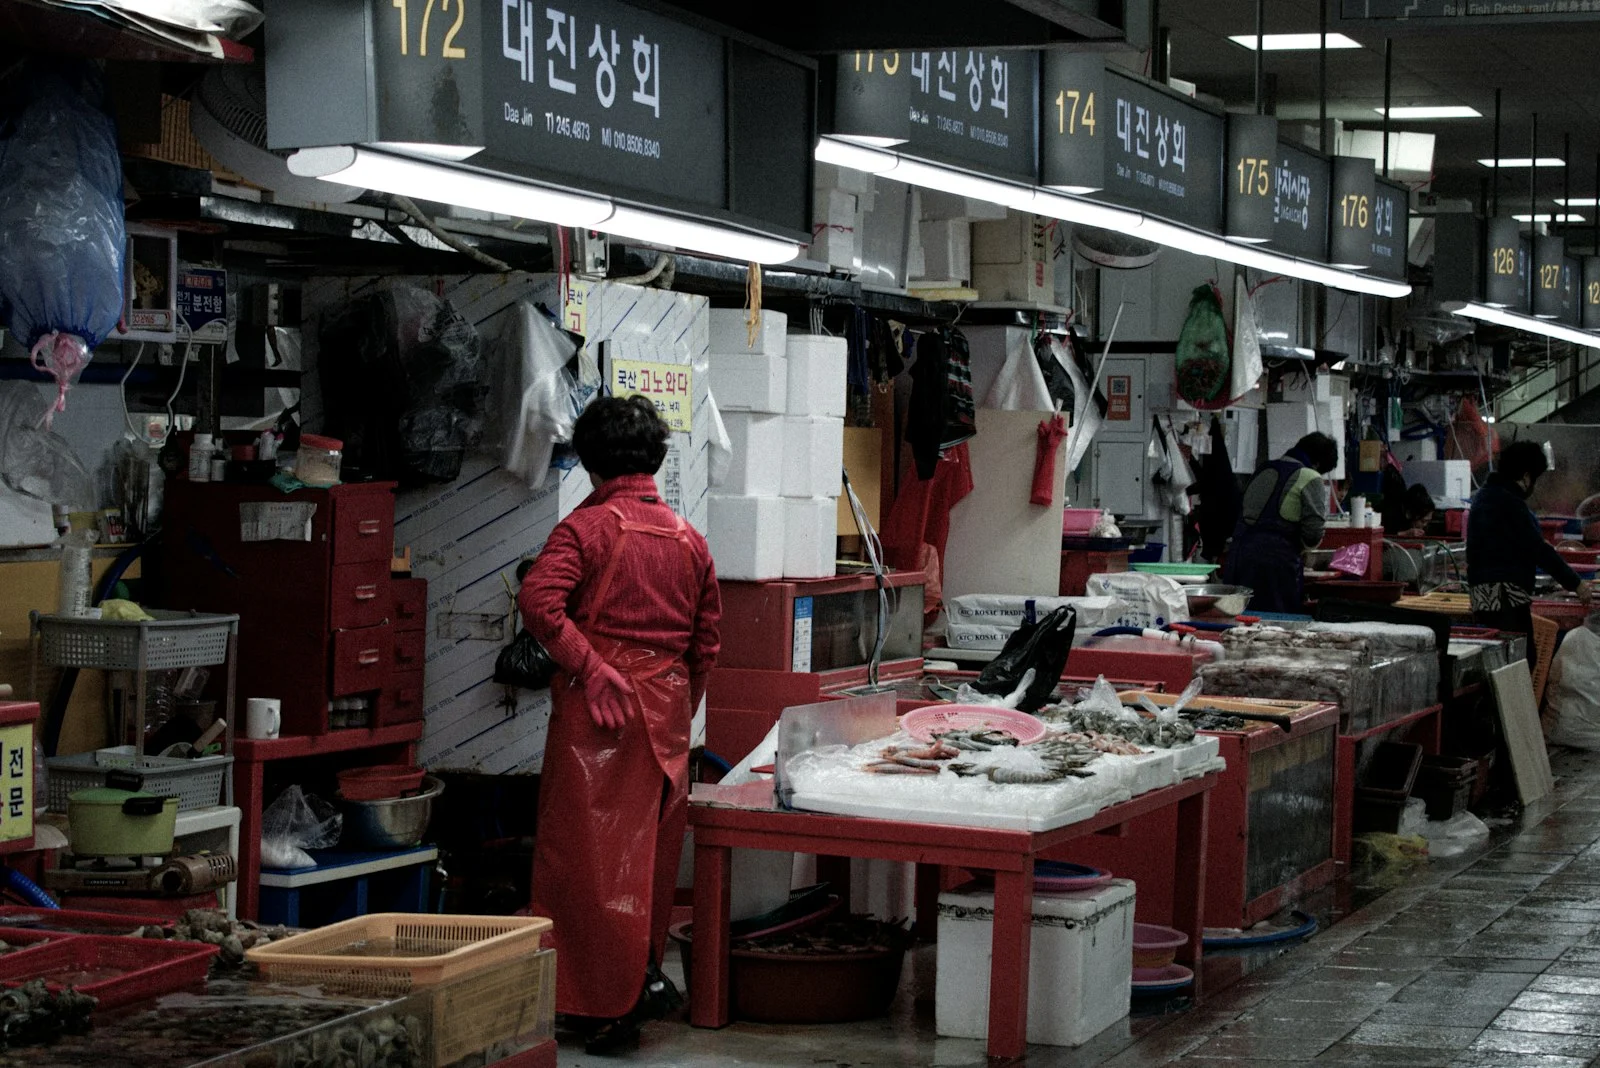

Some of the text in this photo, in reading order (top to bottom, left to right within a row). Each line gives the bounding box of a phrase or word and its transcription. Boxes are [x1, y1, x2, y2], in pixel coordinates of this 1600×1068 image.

[392, 0, 466, 58] 172
[502, 0, 660, 118] 대진상회
[504, 102, 519, 124] Dae
[521, 106, 533, 127] Jin
[556, 115, 591, 142] 245.4873
[1055, 90, 1096, 136] 174
[1117, 98, 1186, 173] 대진상회
[1237, 157, 1269, 196] 175
[1341, 194, 1368, 229] 176
[1493, 247, 1514, 274] 126
[1540, 264, 1560, 289] 127
[193, 294, 223, 313] 분전함
[618, 369, 688, 396] 국산 고노와다
[9, 746, 24, 818] 전문
